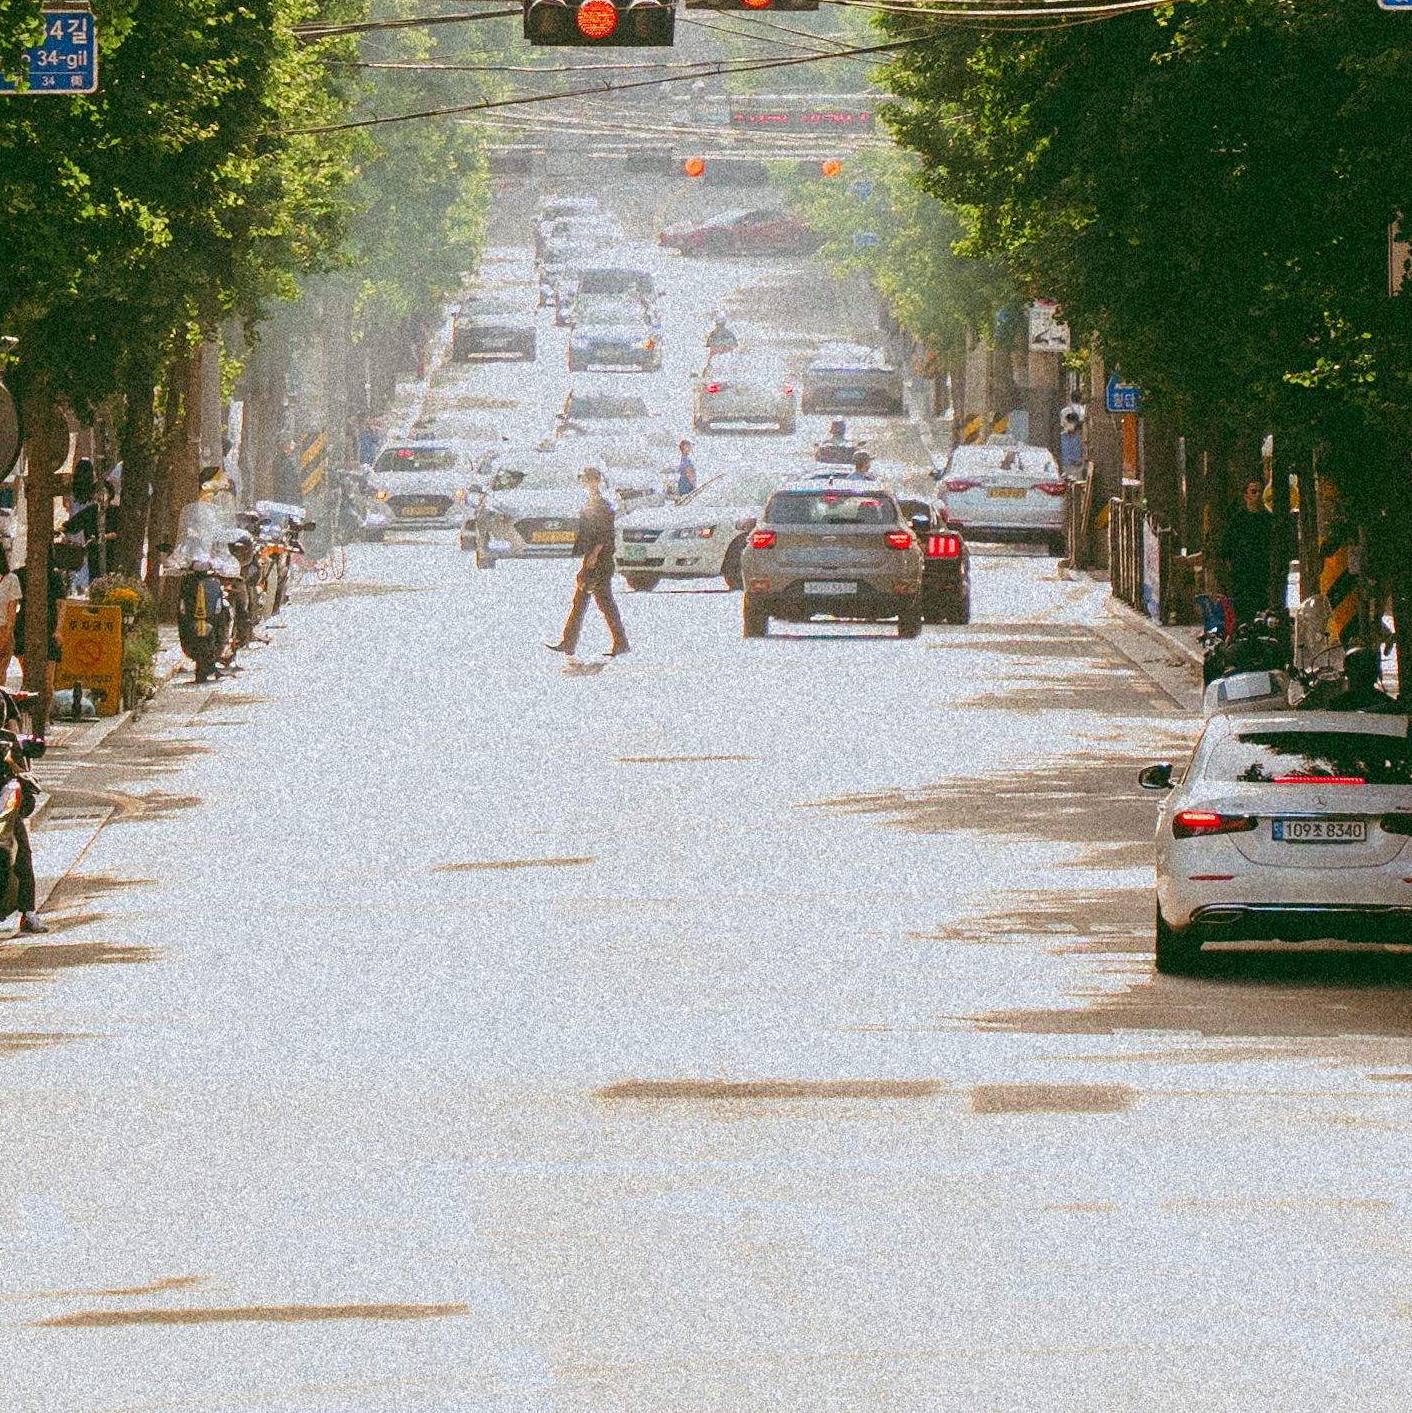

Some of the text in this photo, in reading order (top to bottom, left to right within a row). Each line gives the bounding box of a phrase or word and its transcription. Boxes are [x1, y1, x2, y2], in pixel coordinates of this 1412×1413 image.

[36, 49, 88, 70] 34-gil
[1286, 821, 1363, 840] 109조 8340
